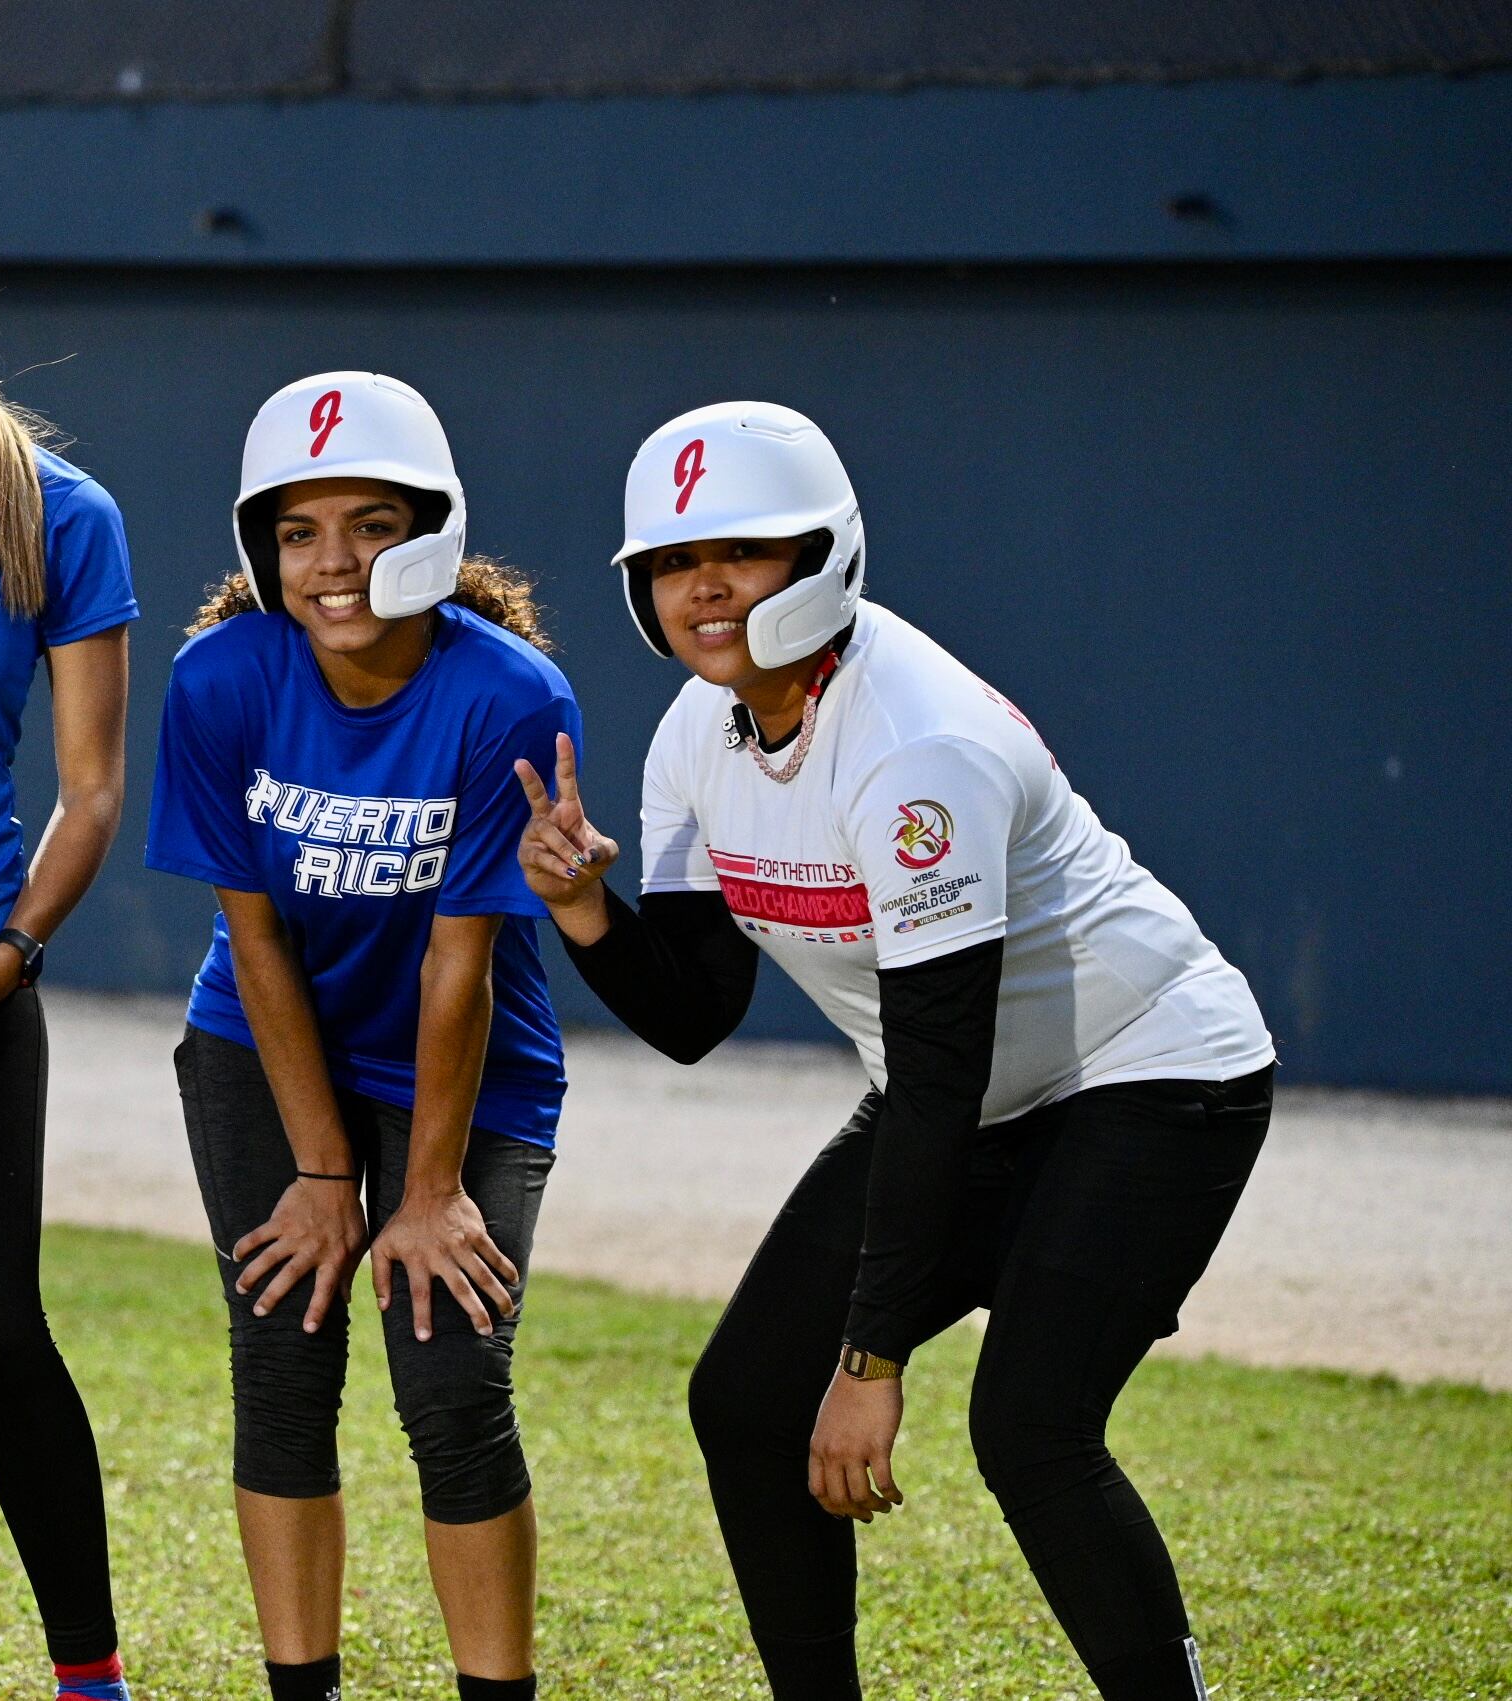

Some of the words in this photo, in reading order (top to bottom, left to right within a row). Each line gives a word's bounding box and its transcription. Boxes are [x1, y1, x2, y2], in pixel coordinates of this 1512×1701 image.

[246, 769, 457, 847] PUERTO
[293, 841, 449, 899] RICO
[756, 858, 779, 879] FOR
[779, 862, 803, 881] THE
[911, 869, 941, 884] WBSC
[879, 889, 928, 914] WOMEN'S
[930, 872, 982, 897] BASEBALL
[900, 897, 939, 917] WORLD
[939, 889, 961, 905] CUP
